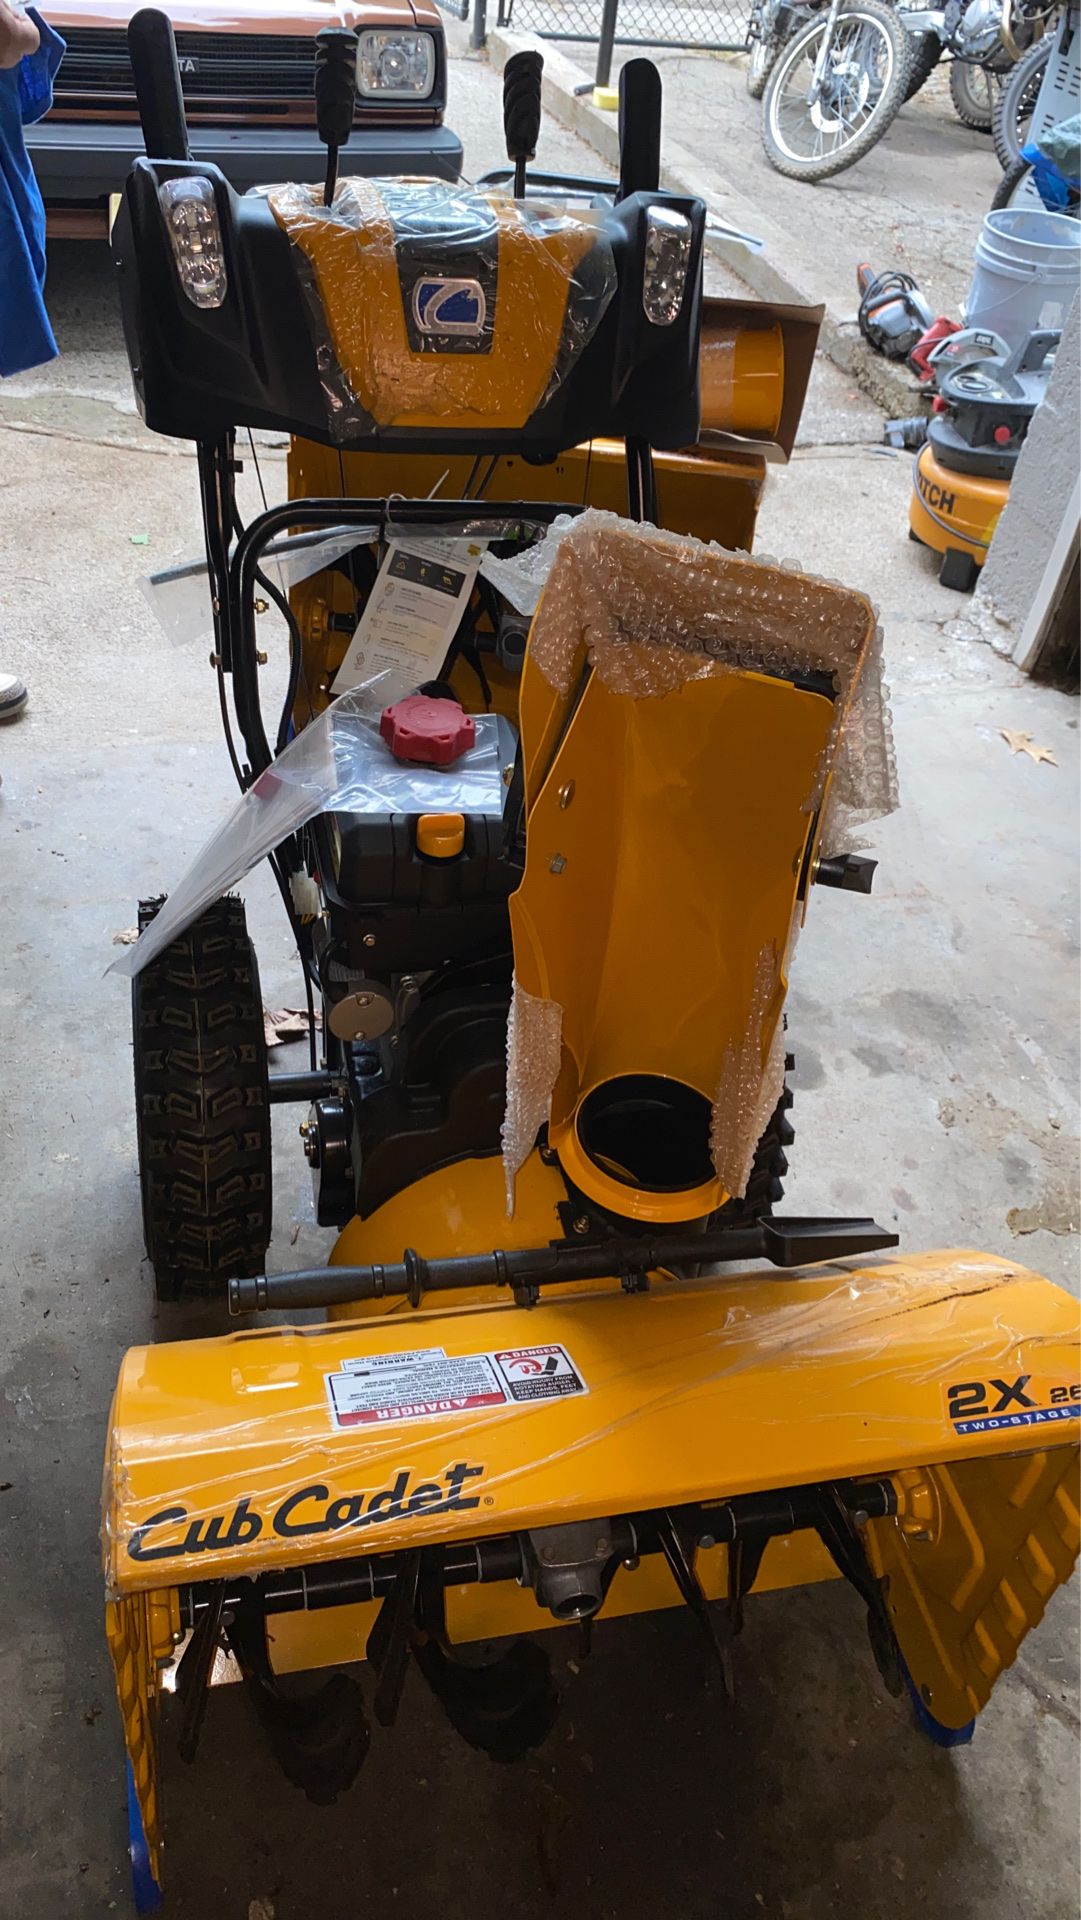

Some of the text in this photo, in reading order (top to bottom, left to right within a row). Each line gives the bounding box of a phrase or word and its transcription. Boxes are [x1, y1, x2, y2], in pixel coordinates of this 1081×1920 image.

[512, 1346, 559, 1357] DANGER
[947, 1375, 1038, 1418] 2X
[376, 1402, 452, 1419] DANGER
[958, 1408, 1072, 1432] TWO-STAGE
[127, 1463, 485, 1562] Cub Cadet
